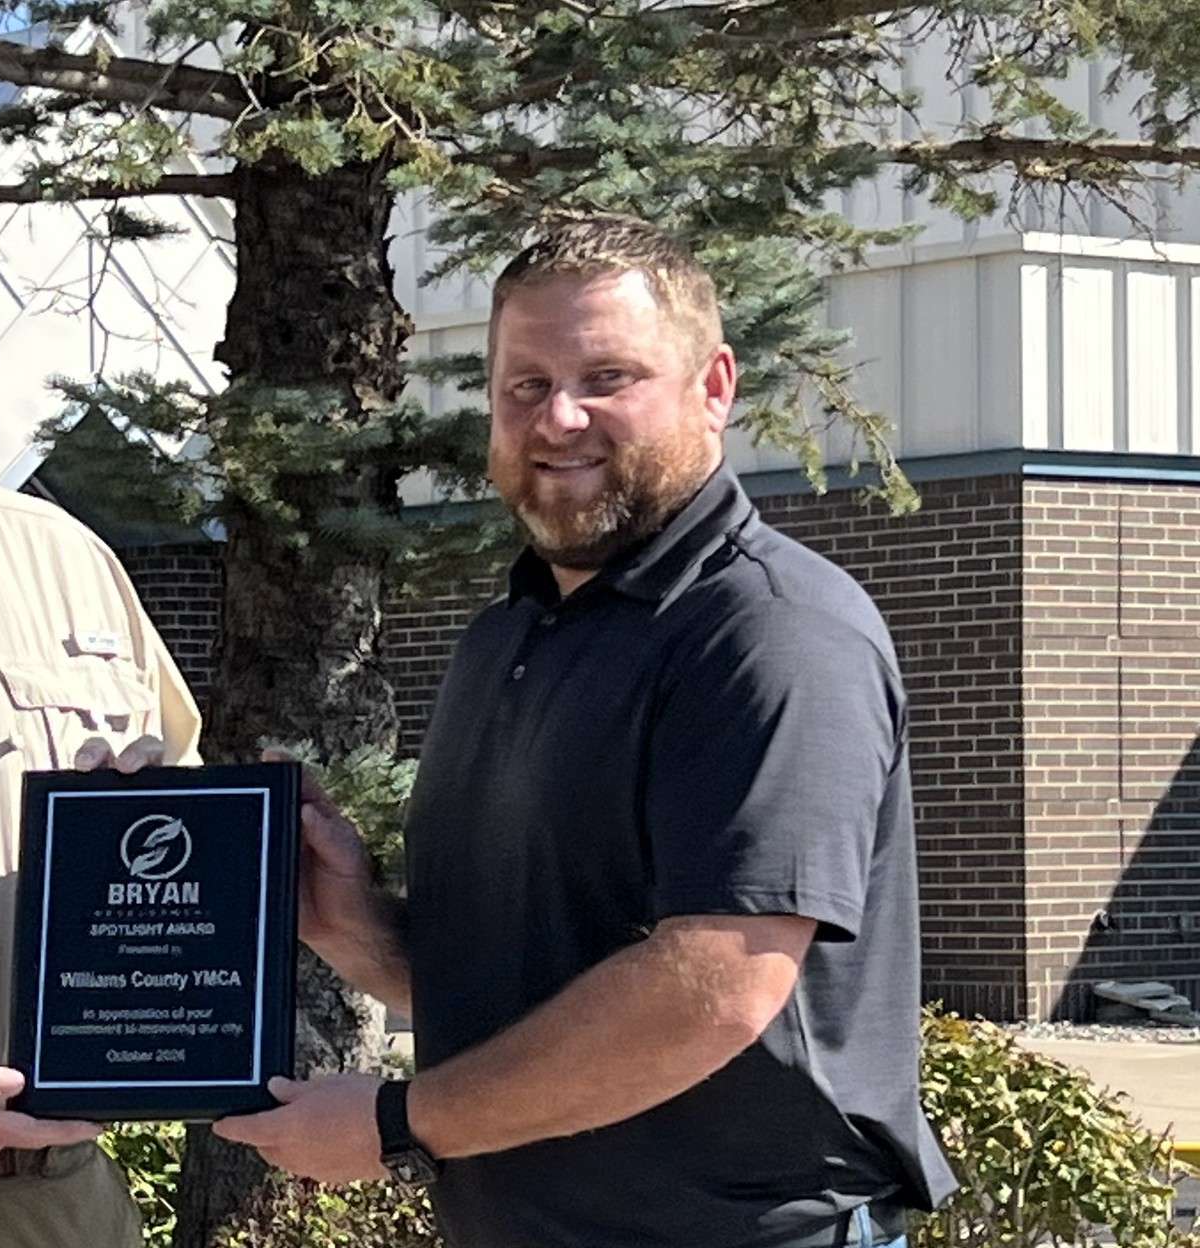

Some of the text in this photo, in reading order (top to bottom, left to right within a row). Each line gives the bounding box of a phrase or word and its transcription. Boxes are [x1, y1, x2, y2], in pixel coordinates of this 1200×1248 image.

[108, 881, 200, 905] BRYAN
[89, 922, 216, 936] SPOTLIGHT AWARD
[59, 969, 242, 992] Williams County YMCA
[106, 1049, 153, 1063] October
